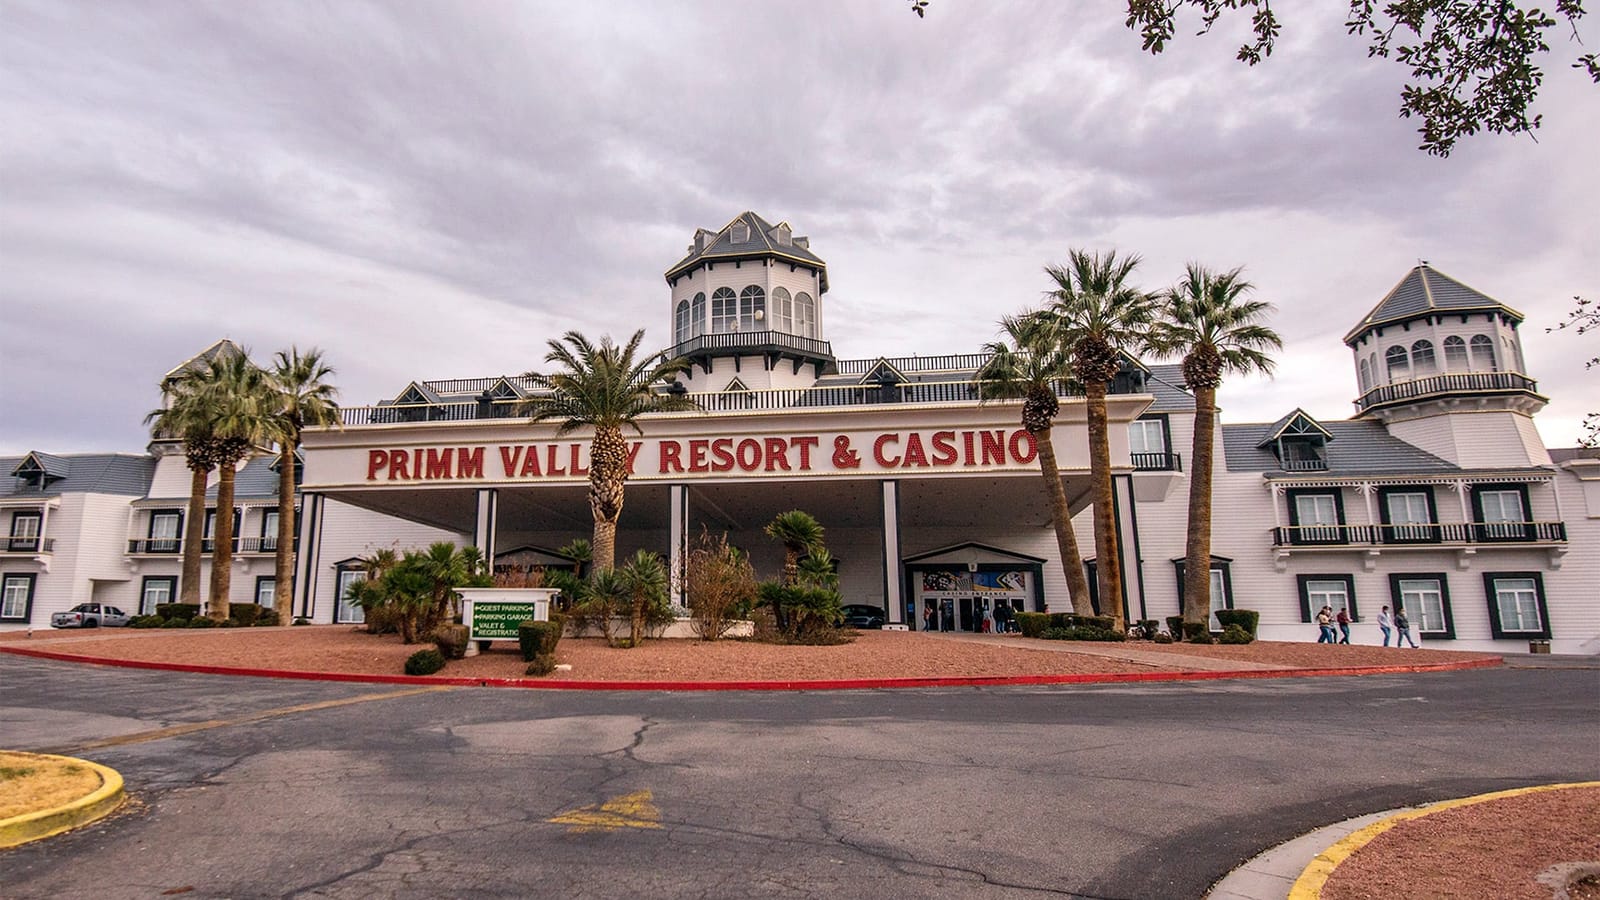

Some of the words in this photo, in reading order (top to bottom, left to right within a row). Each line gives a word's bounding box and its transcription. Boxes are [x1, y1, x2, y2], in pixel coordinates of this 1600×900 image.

[366, 446, 487, 480] PRIMM
[499, 441, 643, 478] VALLY
[659, 435, 819, 473] RESORT
[831, 434, 861, 469] &
[873, 429, 1038, 468] CASINO
